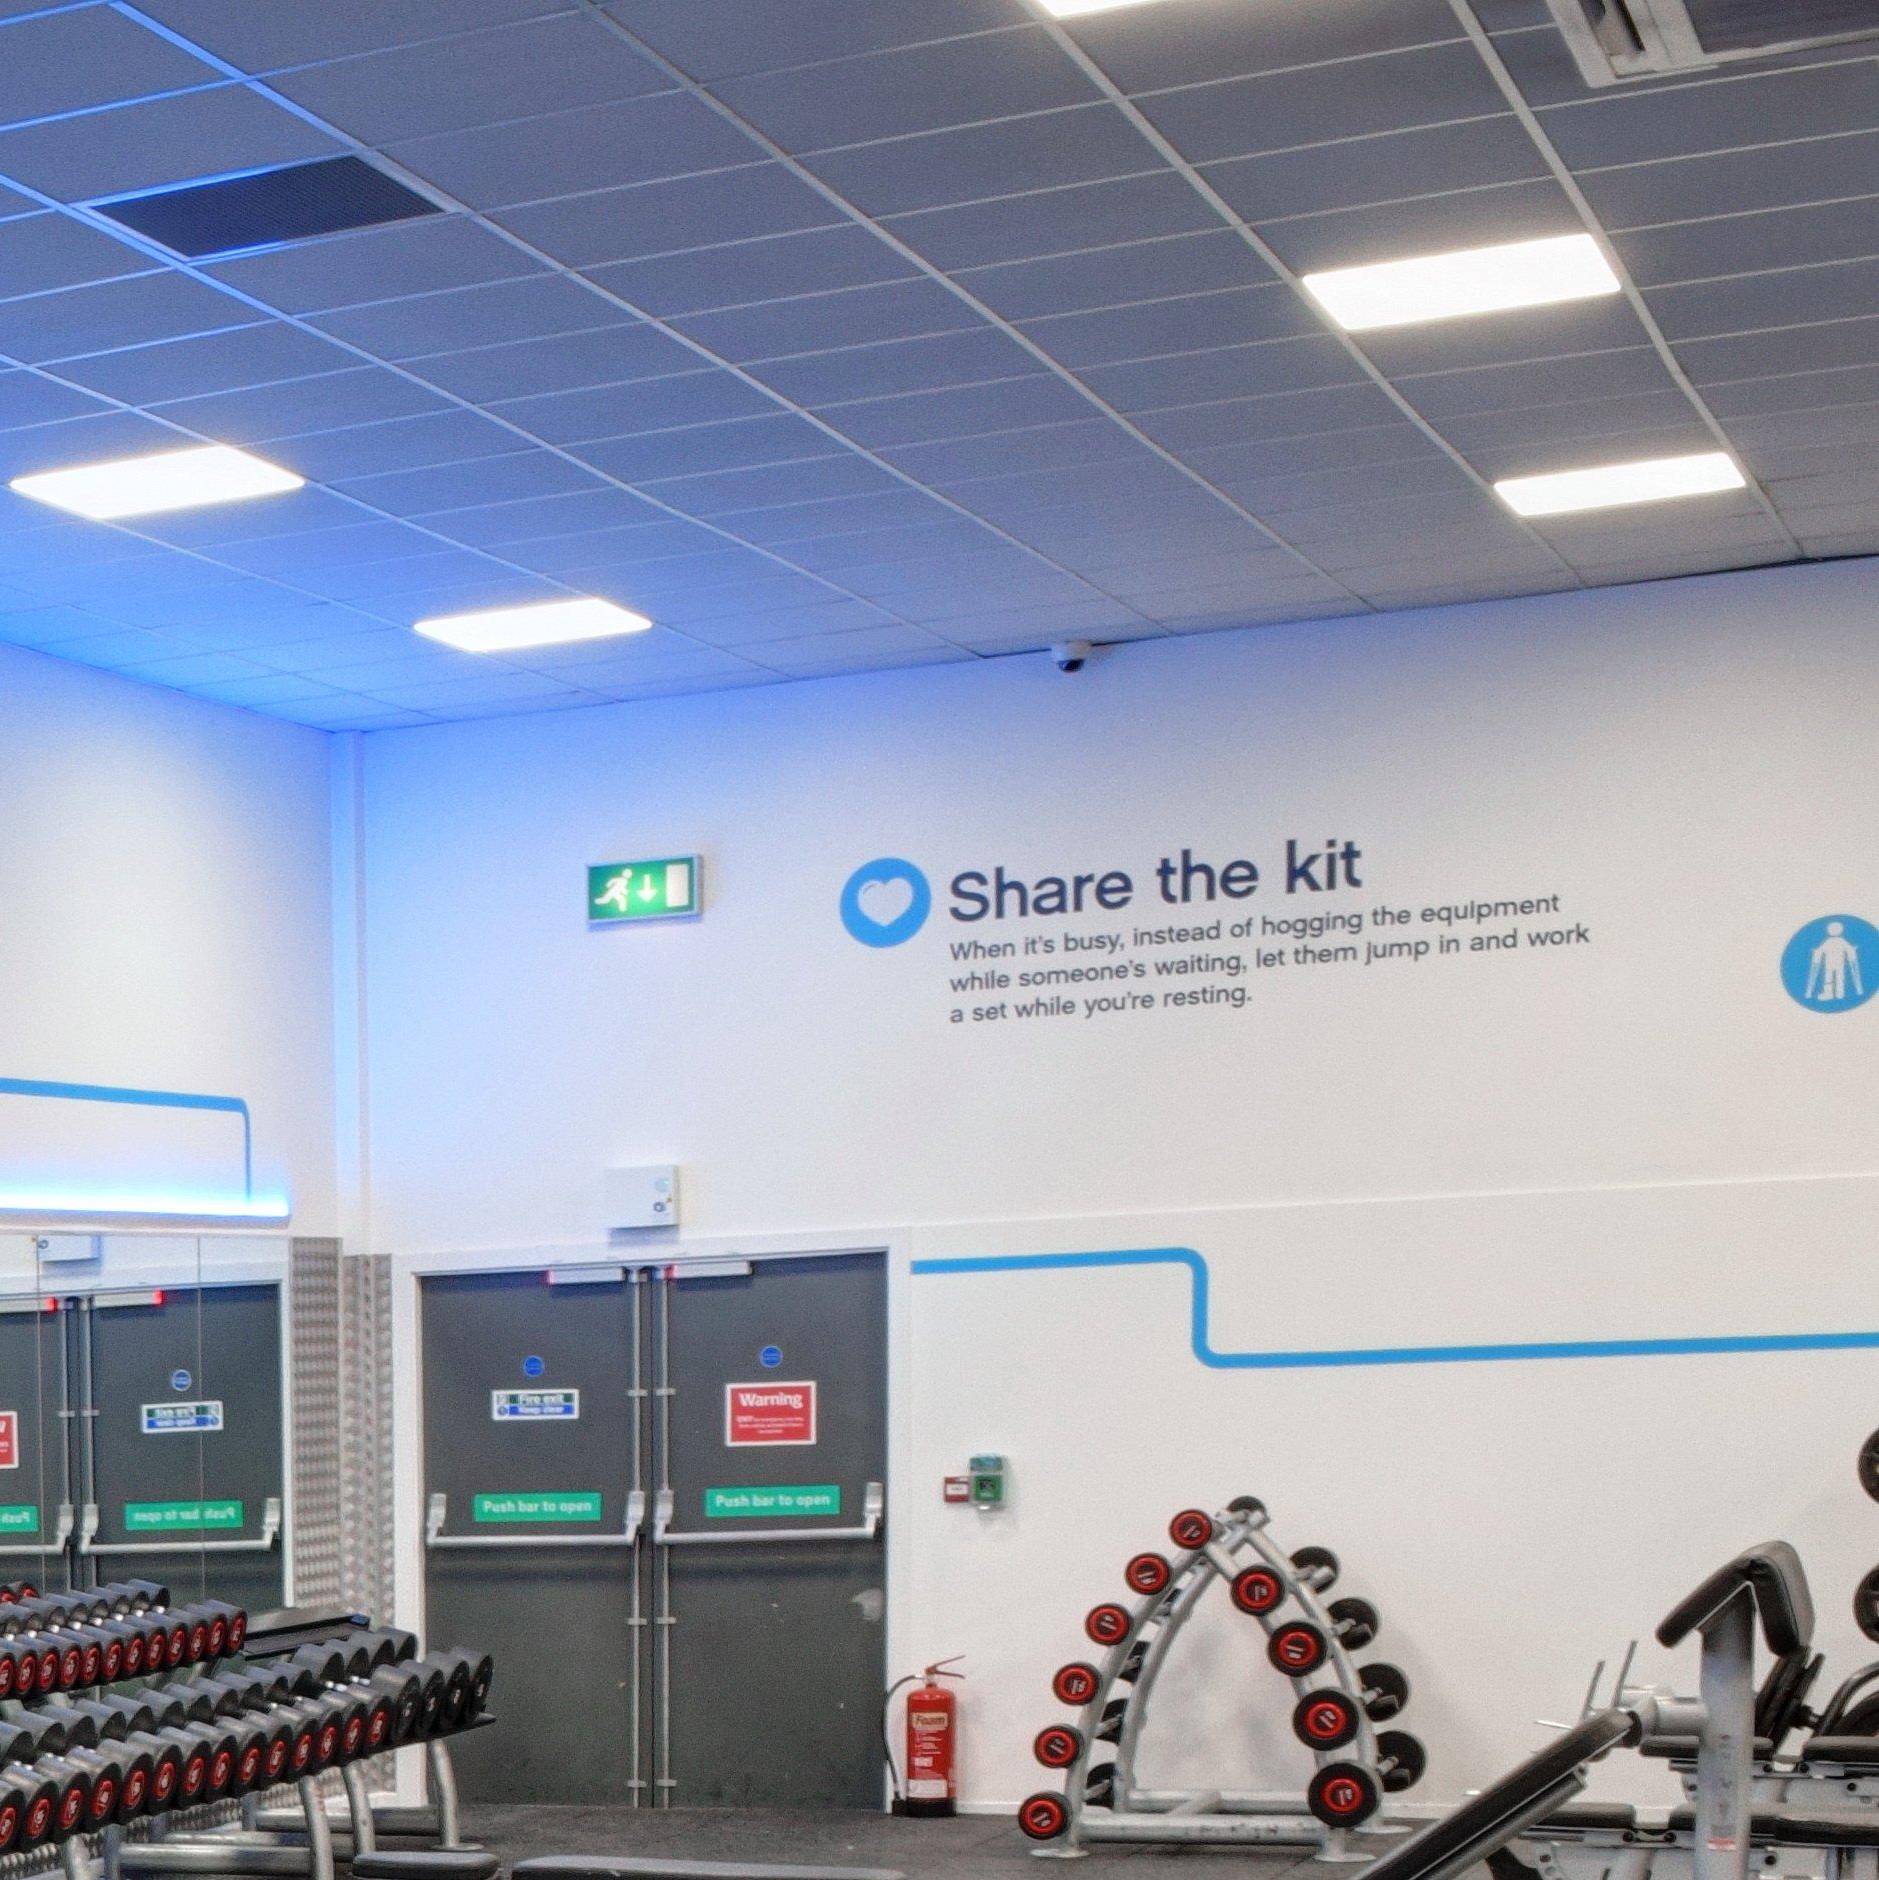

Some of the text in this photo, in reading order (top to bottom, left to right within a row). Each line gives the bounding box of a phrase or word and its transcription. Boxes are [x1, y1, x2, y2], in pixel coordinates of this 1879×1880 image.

[949, 839, 1363, 922] Share the kit
[950, 894, 1560, 961] When it's busy, instead of hogging the equipment
[950, 923, 1590, 993] while someone's waiting, let them jump in and work
[950, 984, 1252, 1024] a set while you're resting.
[738, 1392, 803, 1409] Warning
[483, 1501, 591, 1514] Push bar to open
[715, 1494, 830, 1508] Push bar to open
